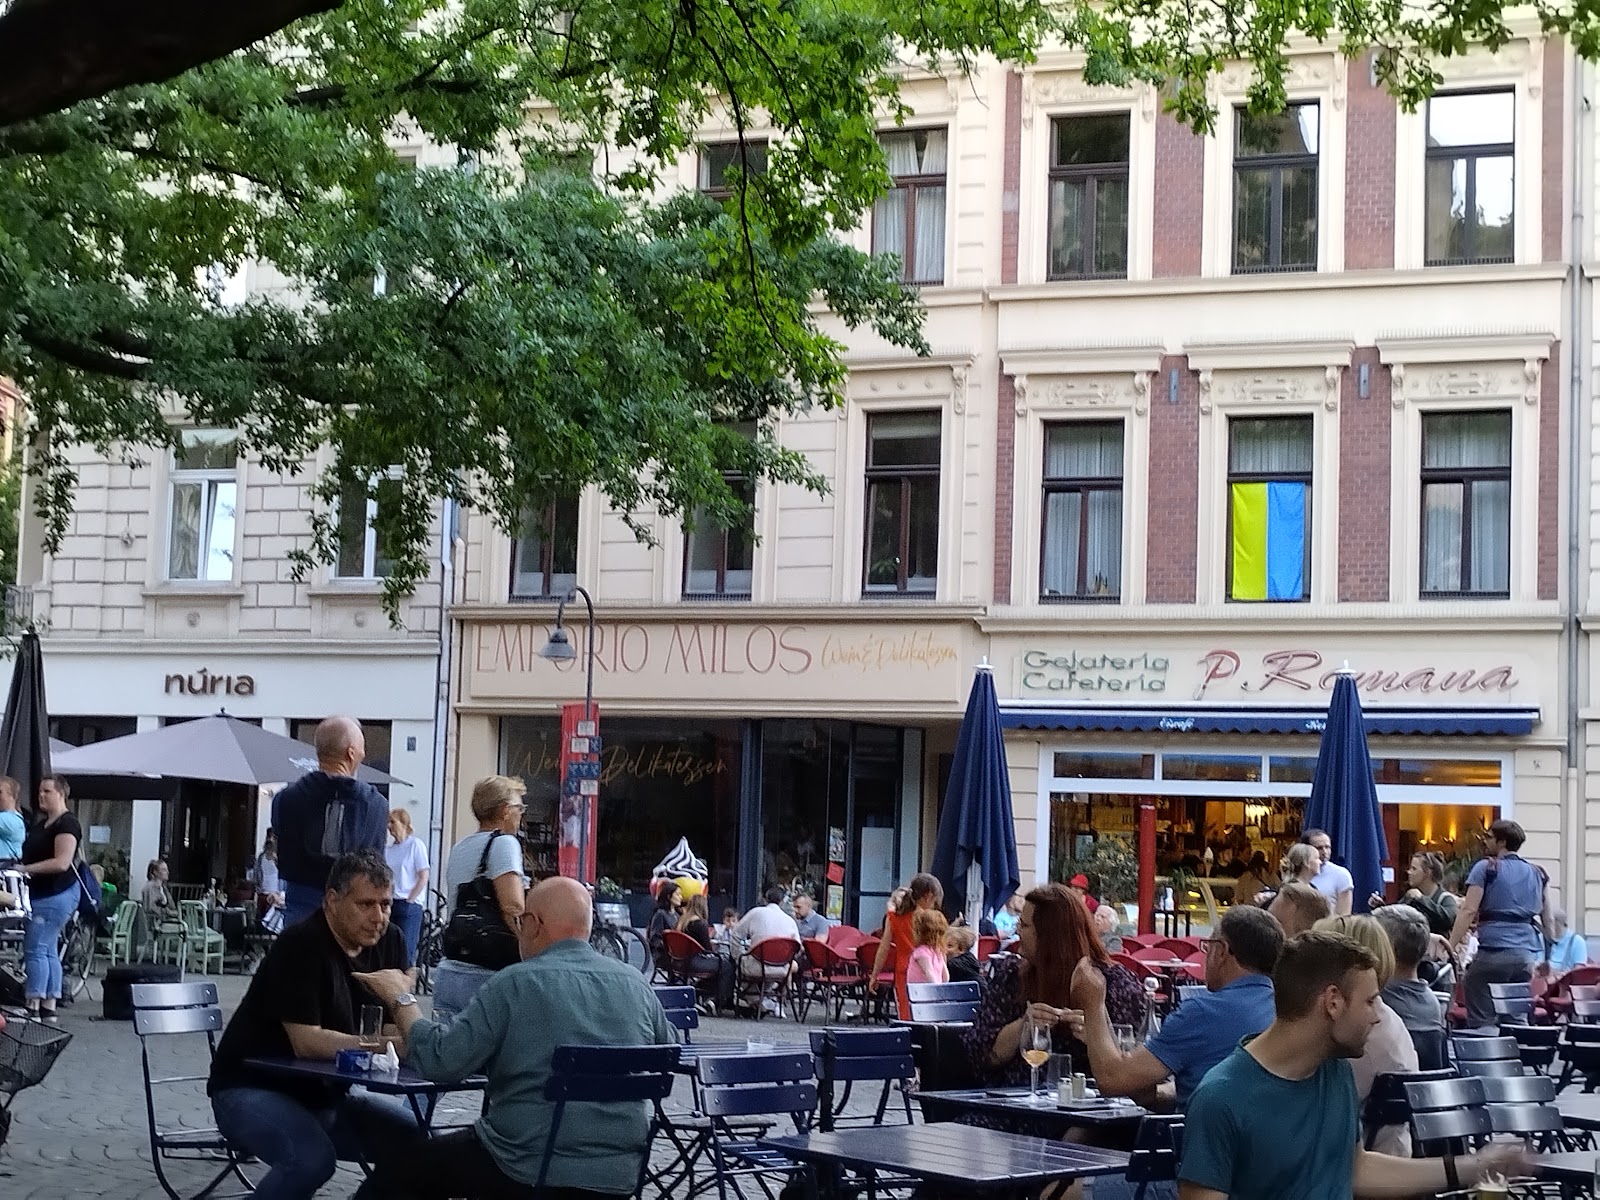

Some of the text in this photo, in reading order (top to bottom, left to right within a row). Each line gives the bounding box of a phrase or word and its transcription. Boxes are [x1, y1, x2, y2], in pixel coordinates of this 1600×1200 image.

[475, 623, 812, 674] EMPORIO MILOS
[1024, 650, 1169, 671] Gelateria
[164, 666, 256, 696] núria
[1023, 672, 1166, 692] Cafeteria
[1260, 650, 1519, 692] Romana
[600, 744, 728, 787] Delikatessen
